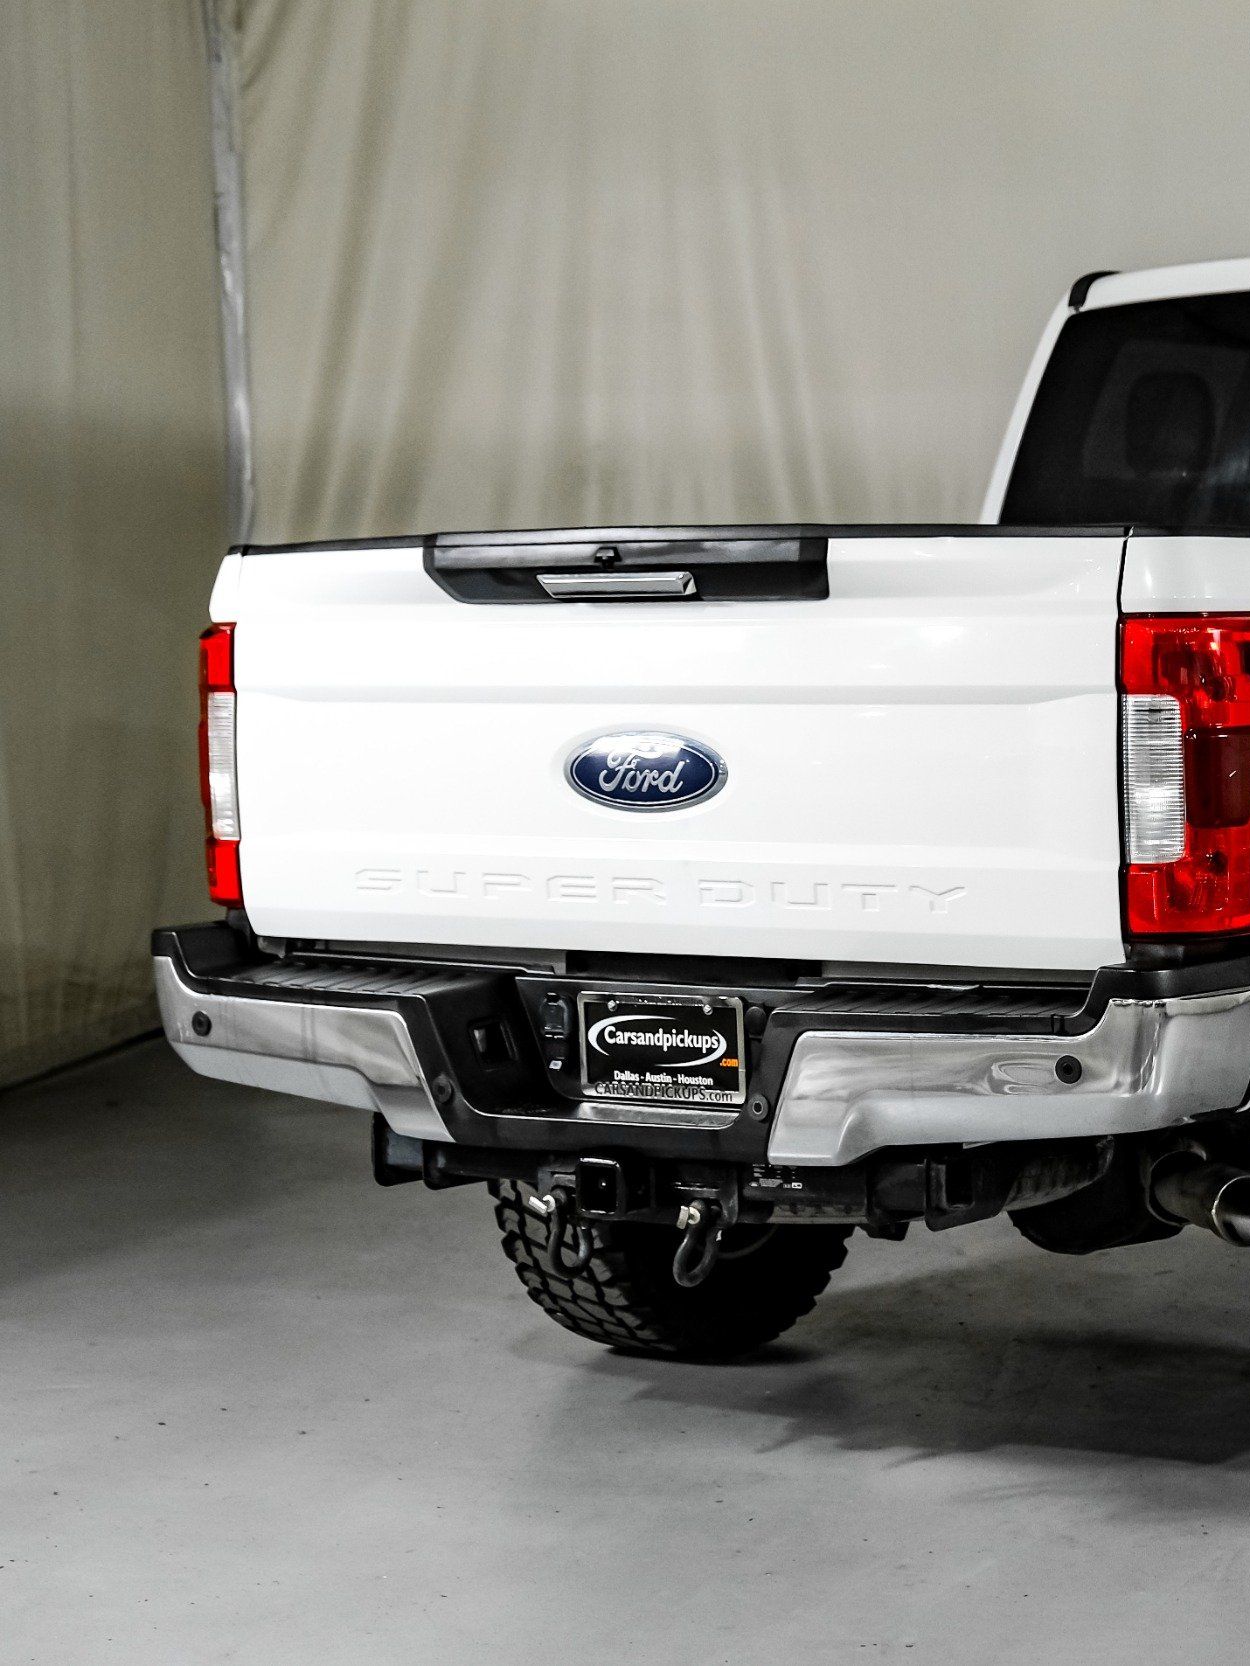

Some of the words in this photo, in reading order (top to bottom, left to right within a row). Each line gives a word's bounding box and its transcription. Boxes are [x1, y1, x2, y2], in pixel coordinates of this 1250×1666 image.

[598, 747, 688, 793] Ford
[354, 867, 670, 907] SUPER
[698, 878, 968, 914] DUTY
[603, 1025, 719, 1054] Carsandpickups
[594, 1081, 733, 1102] CARSANDPICKUPS.com
[613, 1070, 640, 1081] Dallas
[645, 1072, 672, 1083] Austin
[677, 1074, 714, 1086] Houston
